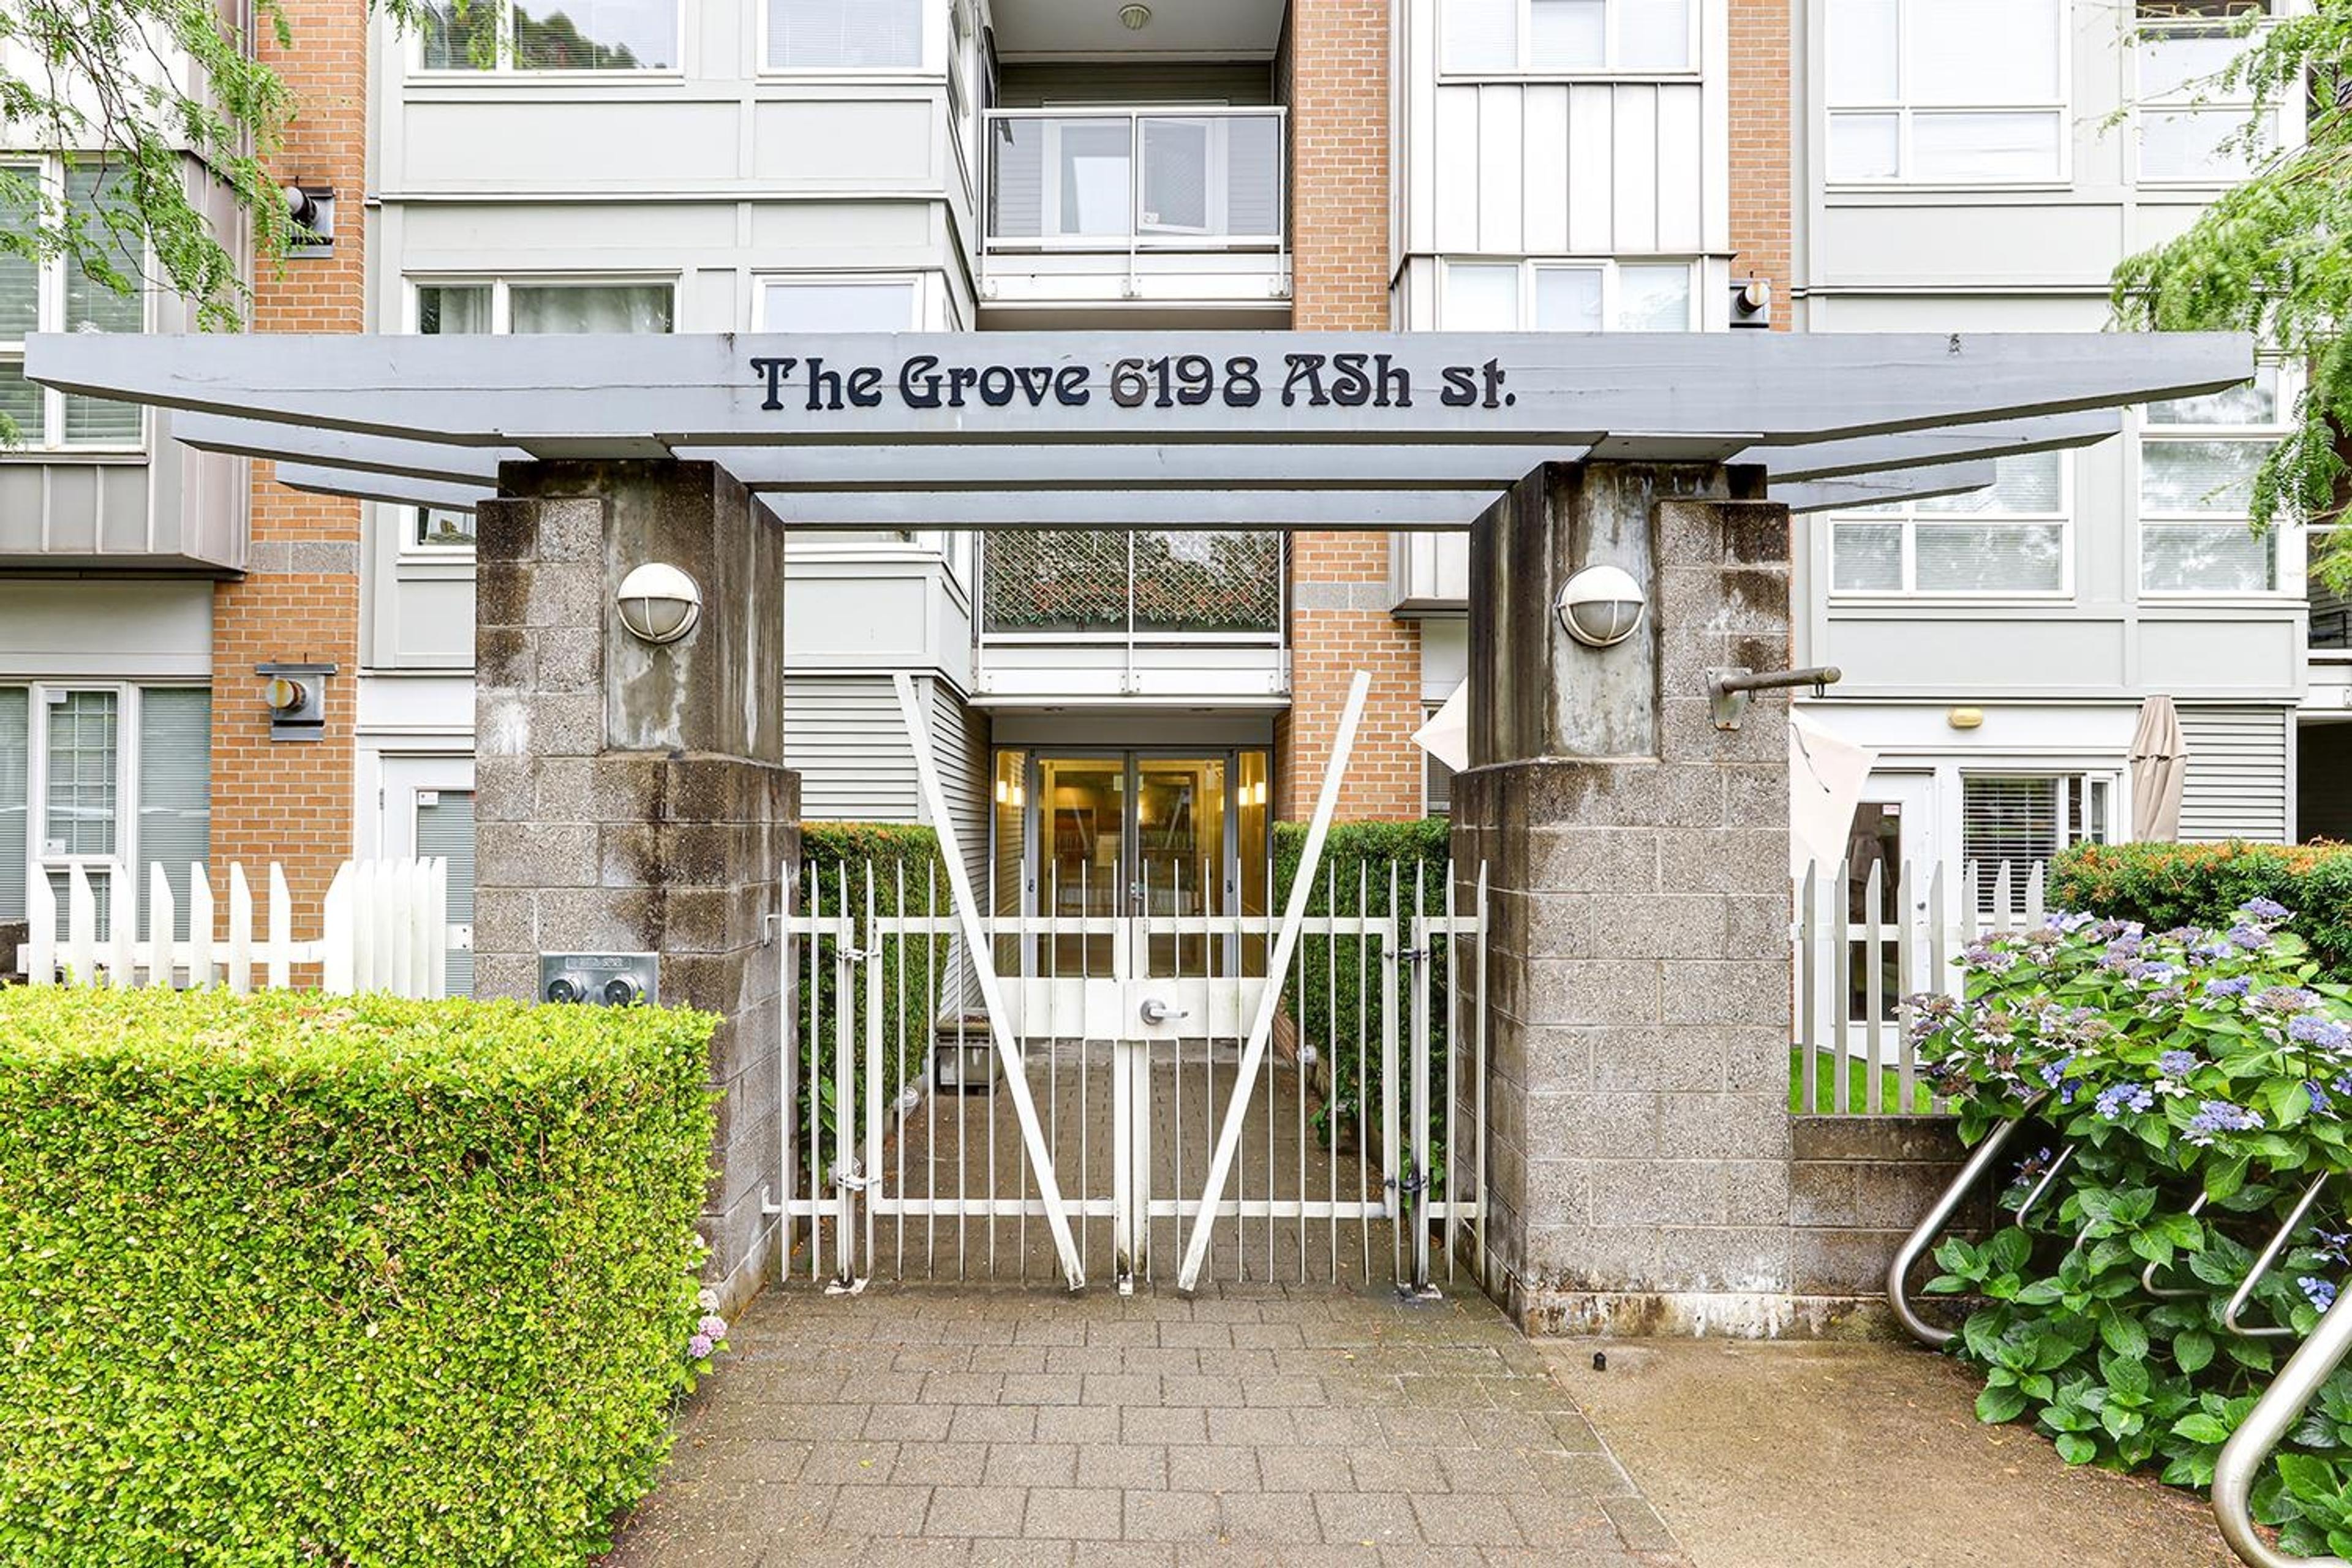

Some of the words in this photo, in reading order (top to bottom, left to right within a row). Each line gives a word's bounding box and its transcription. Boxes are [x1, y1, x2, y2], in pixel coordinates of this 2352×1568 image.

[750, 357, 883, 411] The
[899, 355, 1090, 409] Grove
[1110, 353, 1262, 409] 6198
